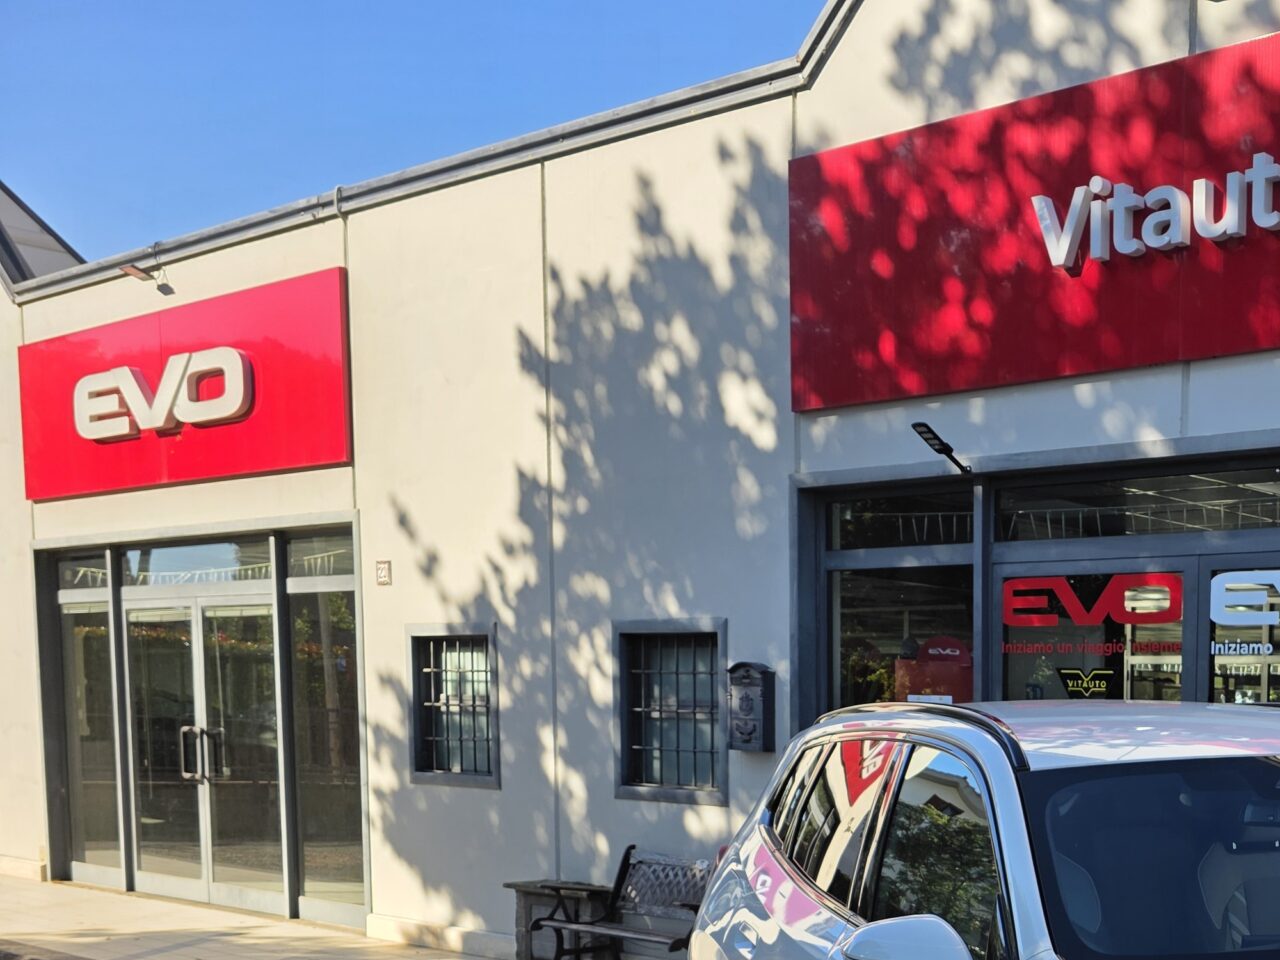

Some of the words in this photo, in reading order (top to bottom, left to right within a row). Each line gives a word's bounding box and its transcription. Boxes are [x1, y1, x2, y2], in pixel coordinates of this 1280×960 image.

[73, 346, 252, 441] EVO
[1003, 572, 1184, 627] EVO
[928, 647, 960, 656] EVO
[1002, 640, 1054, 654] Iniziamo
[1057, 642, 1073, 654] un
[1077, 639, 1125, 656] viaggio
[1128, 640, 1182, 654] nsieme
[1211, 638, 1273, 655] Iniziamo
[1066, 679, 1107, 688] VITAUTO
